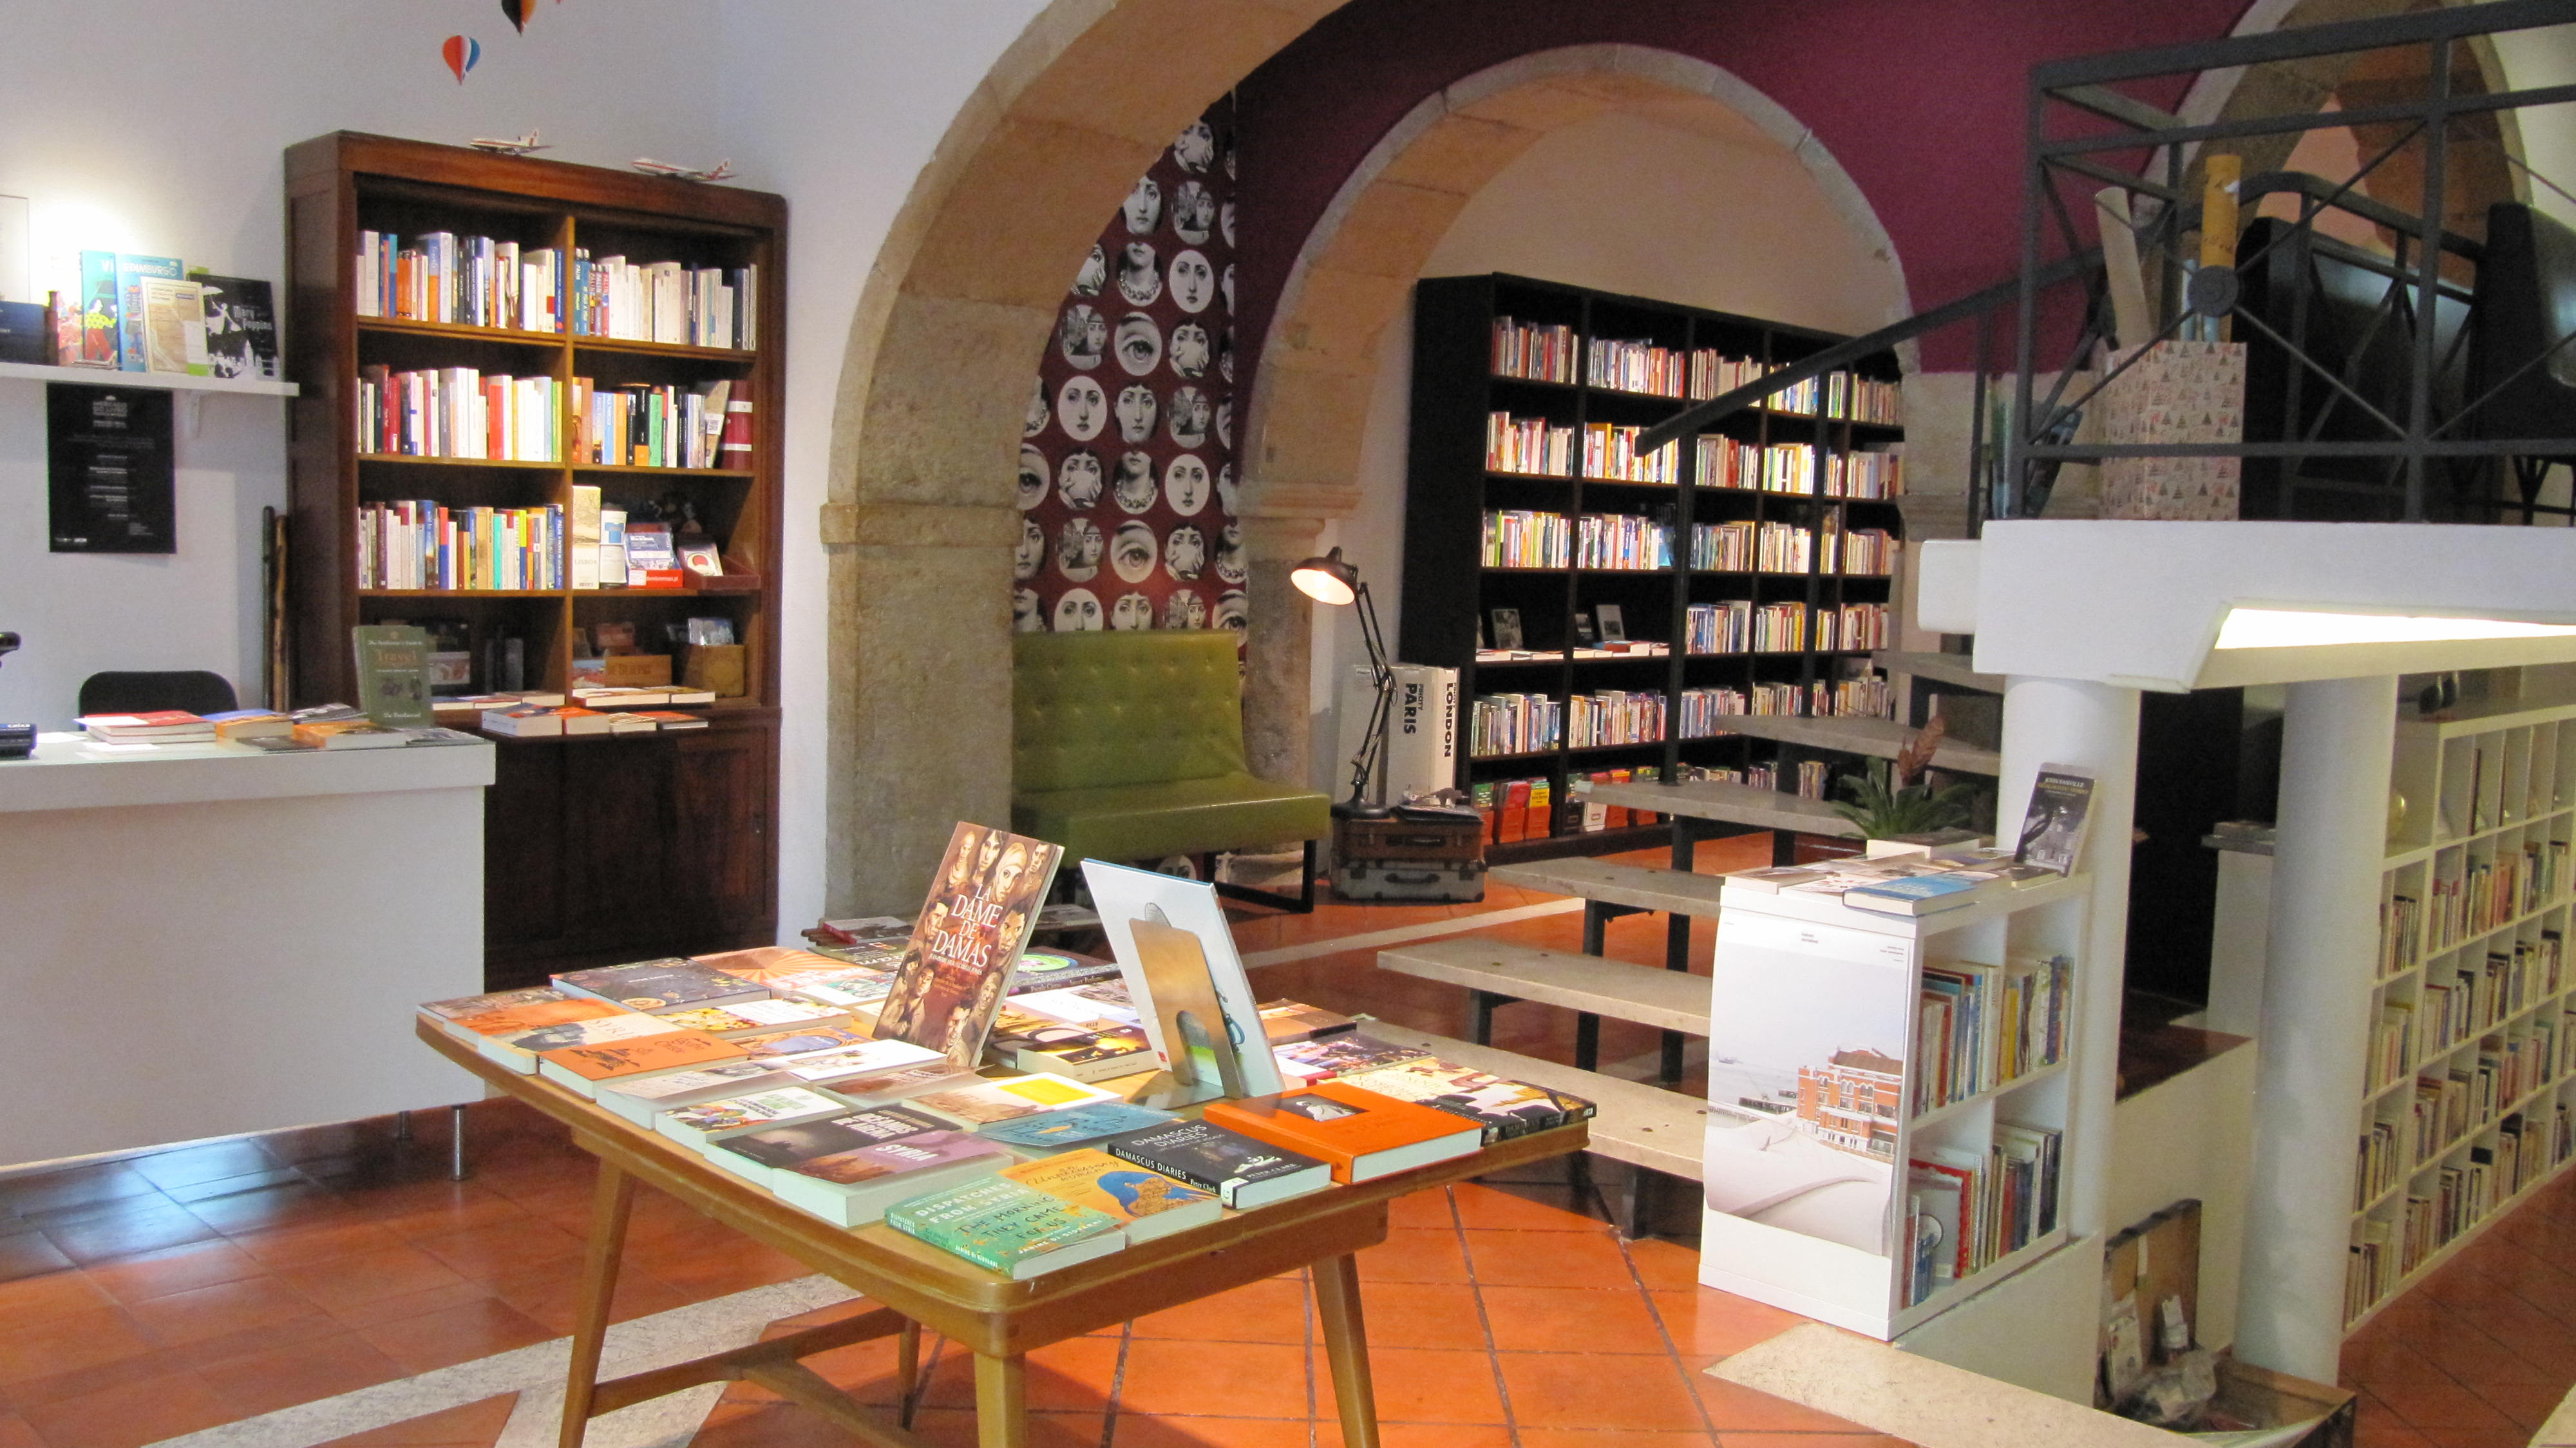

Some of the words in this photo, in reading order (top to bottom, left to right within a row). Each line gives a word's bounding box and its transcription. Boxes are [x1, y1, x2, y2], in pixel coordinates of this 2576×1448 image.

[374, 650, 417, 661] Travel
[1403, 683, 1417, 734] PARIS
[1444, 682, 1454, 757] LONDON
[975, 884, 992, 901] LA
[951, 894, 1003, 928] DAME
[960, 920, 980, 940] DE
[932, 930, 992, 967] DAMAS
[875, 1144, 939, 1161] SYRIA
[1132, 1125, 1208, 1147] DAMASCUS
[1153, 1131, 1208, 1147] DIARIES
[1115, 1148, 1155, 1168] DAMASCUS
[1157, 1162, 1187, 1180] DIARIES
[1190, 1178, 1202, 1188] Peter
[1203, 1183, 1217, 1194] Clark
[914, 1182, 1013, 1216] DISPATCHES
[929, 1205, 977, 1223] FROM
[980, 1188, 1030, 1206] SYRIA
[954, 1220, 989, 1235] THE
[993, 1196, 1056, 1222] MORNING
[981, 1222, 1020, 1237] THEY
[1025, 1205, 1064, 1223] CAME
[1016, 1226, 1043, 1239] FOR
[1049, 1217, 1067, 1228] US
